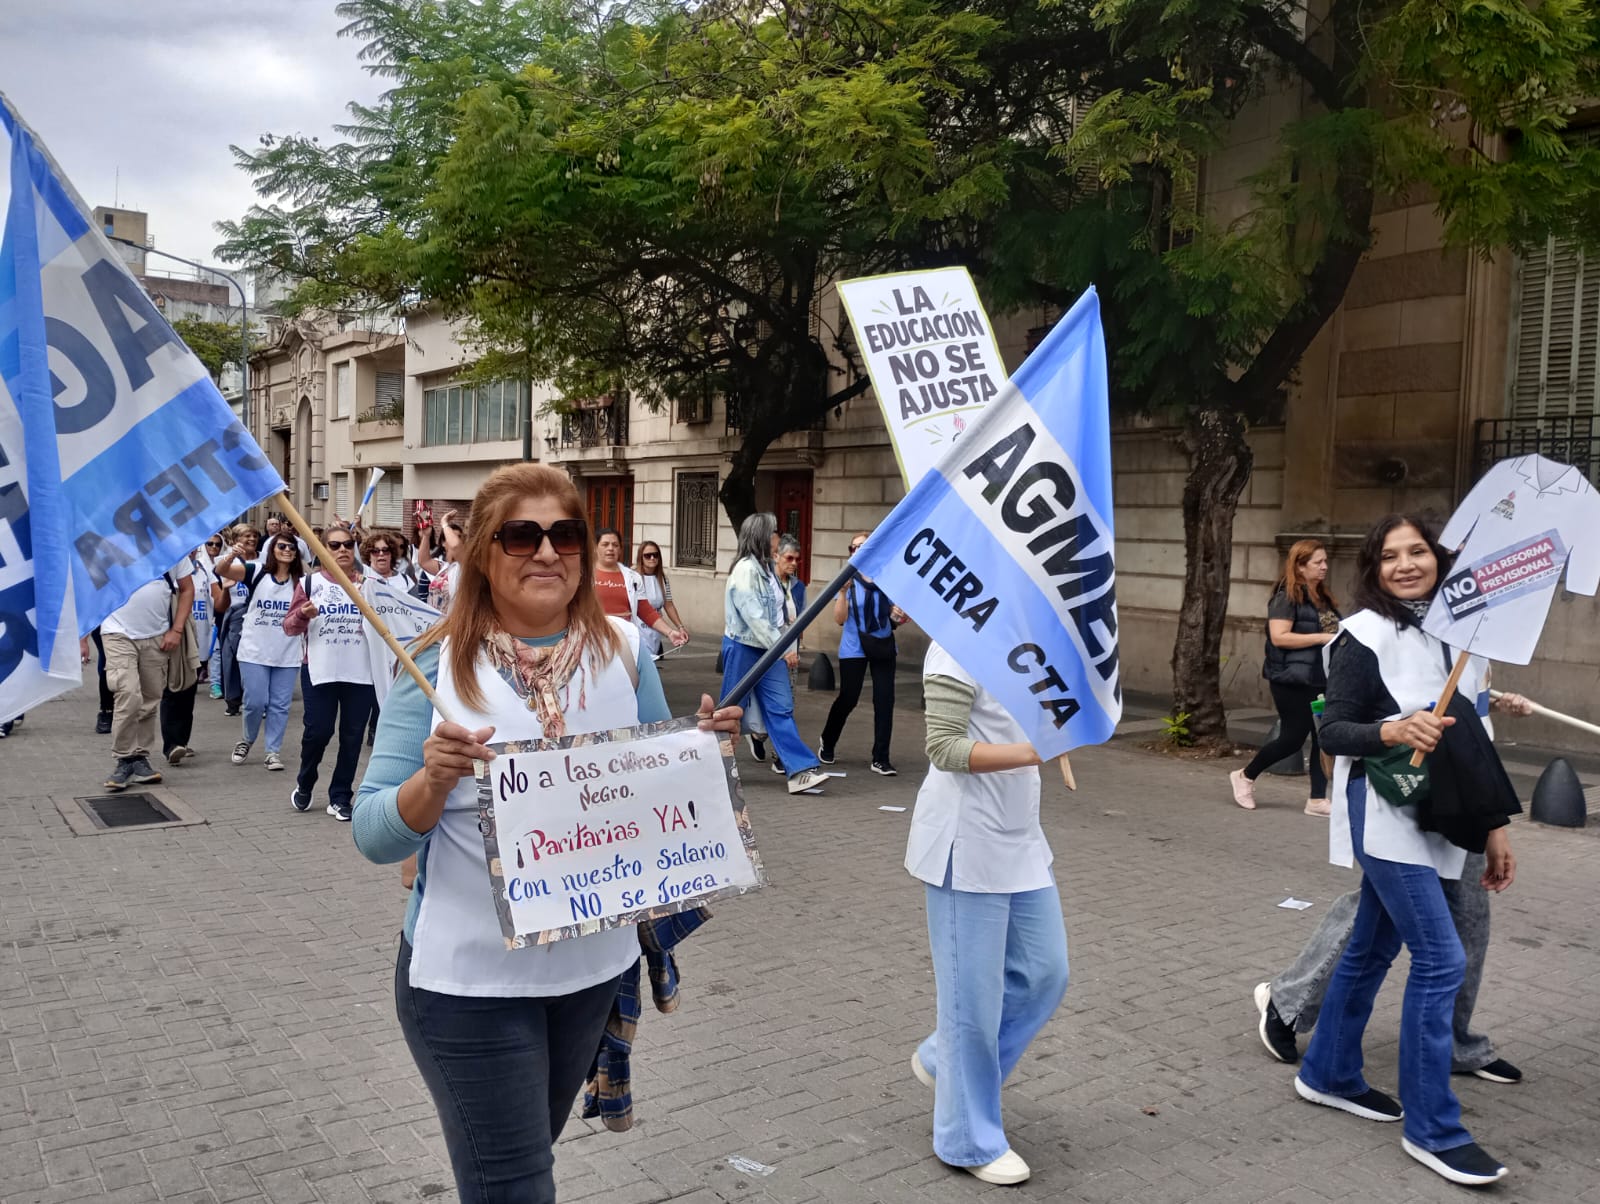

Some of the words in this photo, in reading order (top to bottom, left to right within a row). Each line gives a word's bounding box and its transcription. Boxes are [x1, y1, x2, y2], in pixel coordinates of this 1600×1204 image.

[892, 285, 935, 316] LA
[863, 308, 986, 353] EDUCACIÓN
[888, 350, 940, 385] NO
[944, 342, 986, 374] SE
[899, 373, 999, 420] AJUSTA
[1443, 577, 1477, 604] NO
[1476, 570, 1486, 579] A
[1485, 563, 1501, 575] LA
[1500, 542, 1553, 569] REFORMA
[1481, 557, 1552, 591] PREVISIONAL
[256, 600, 290, 610] AGME
[317, 602, 362, 616] AGME
[903, 527, 1000, 633] CTERA
[1007, 642, 1081, 730] CTA
[538, 770, 555, 789] a
[564, 755, 601, 783] las
[679, 748, 702, 763] en
[652, 800, 699, 833] YA!
[508, 877, 551, 902] Con
[560, 853, 642, 892] nuestro
[570, 892, 602, 922] NO
[622, 887, 647, 909] se
